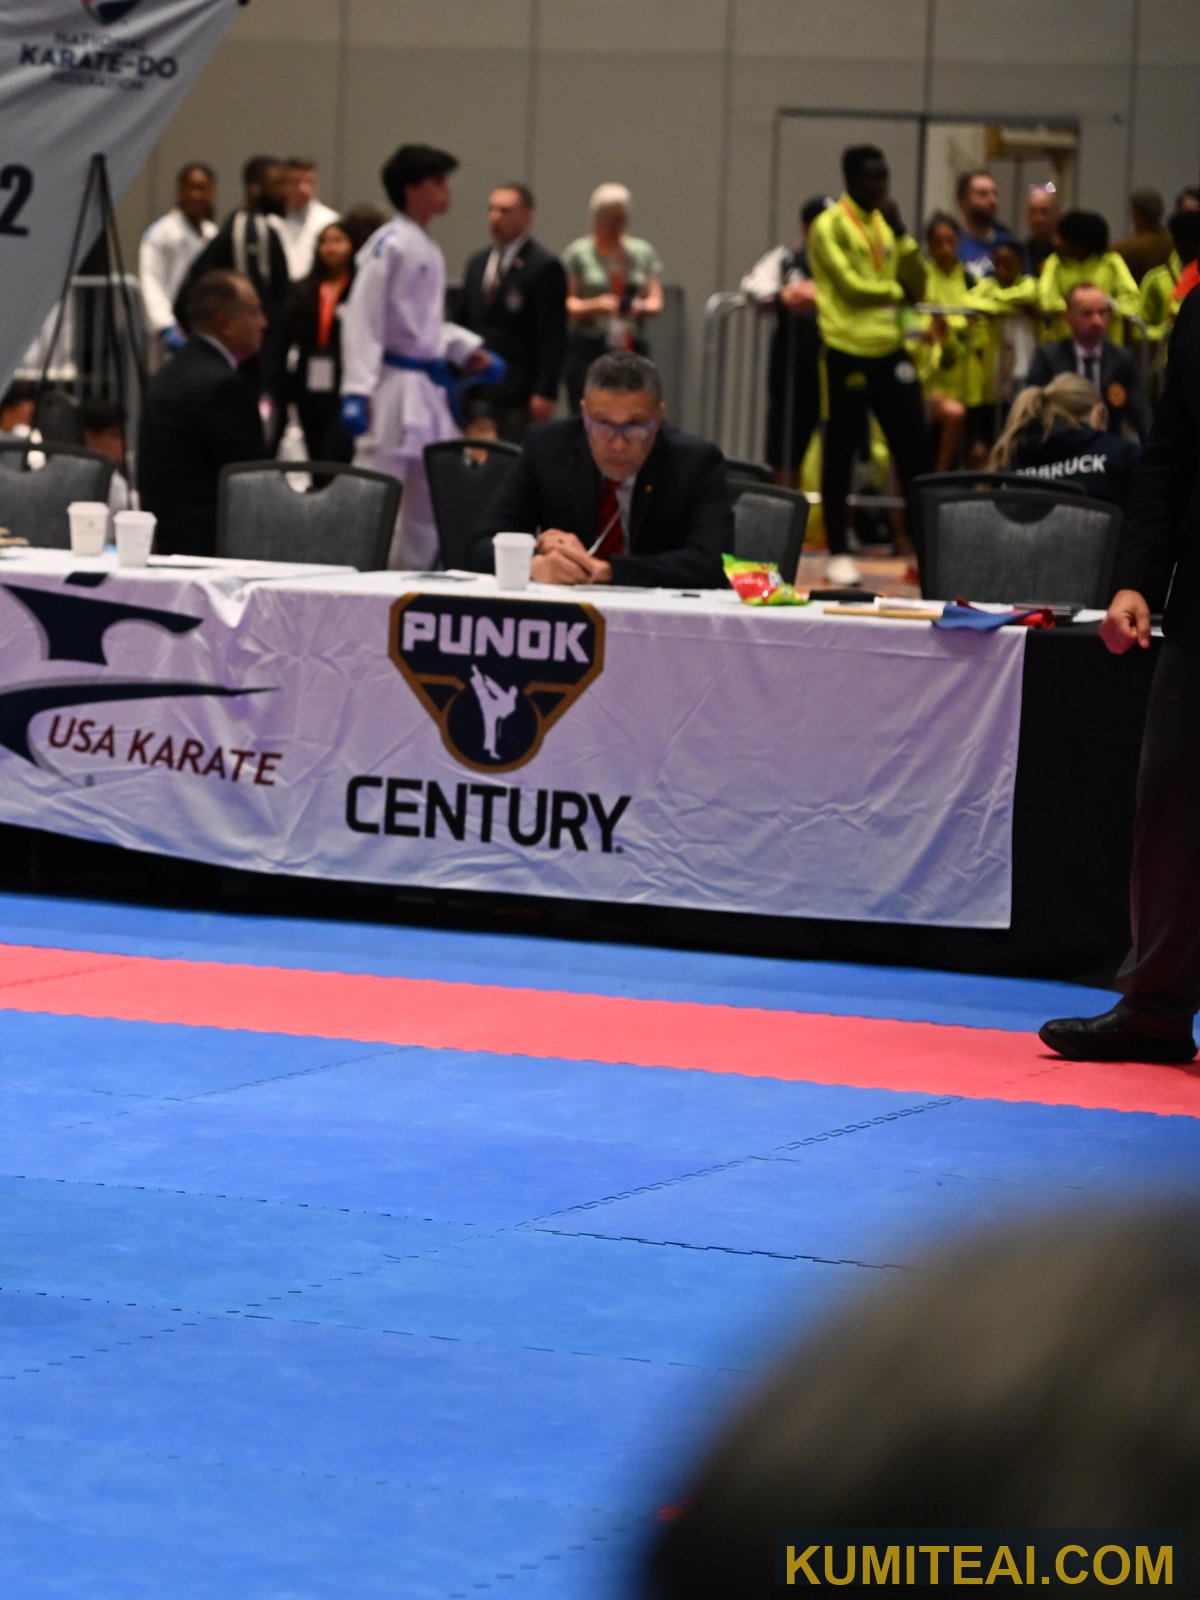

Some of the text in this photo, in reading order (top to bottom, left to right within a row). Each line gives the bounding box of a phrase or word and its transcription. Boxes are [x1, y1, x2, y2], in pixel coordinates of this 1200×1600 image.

[19, 43, 178, 79] KARATE-DO
[402, 610, 590, 664] PUNOK
[48, 714, 284, 787] USA KARATE
